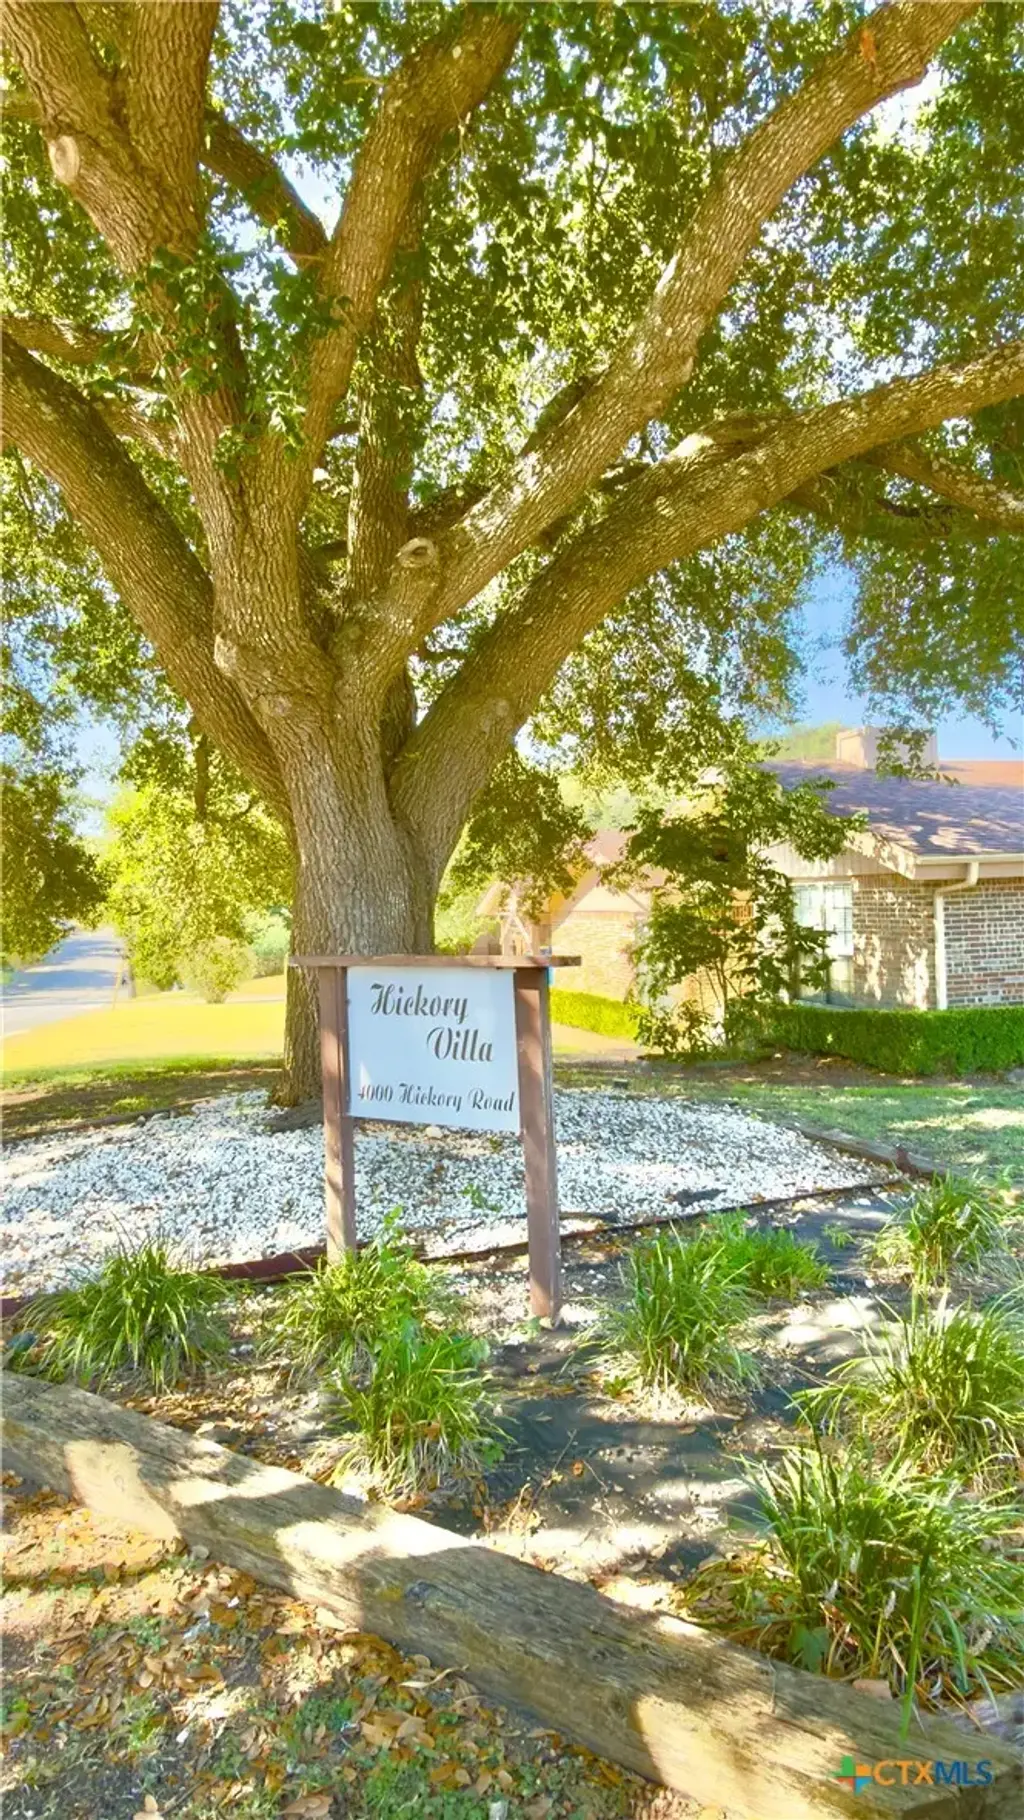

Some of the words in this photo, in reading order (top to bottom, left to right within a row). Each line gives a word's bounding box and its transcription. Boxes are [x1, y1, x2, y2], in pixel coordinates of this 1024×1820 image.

[371, 982, 468, 1024] Hickory
[426, 1026, 493, 1062] Villa
[357, 1084, 394, 1102] 4000
[399, 1082, 463, 1112] Hickory
[468, 1087, 516, 1112] Road
